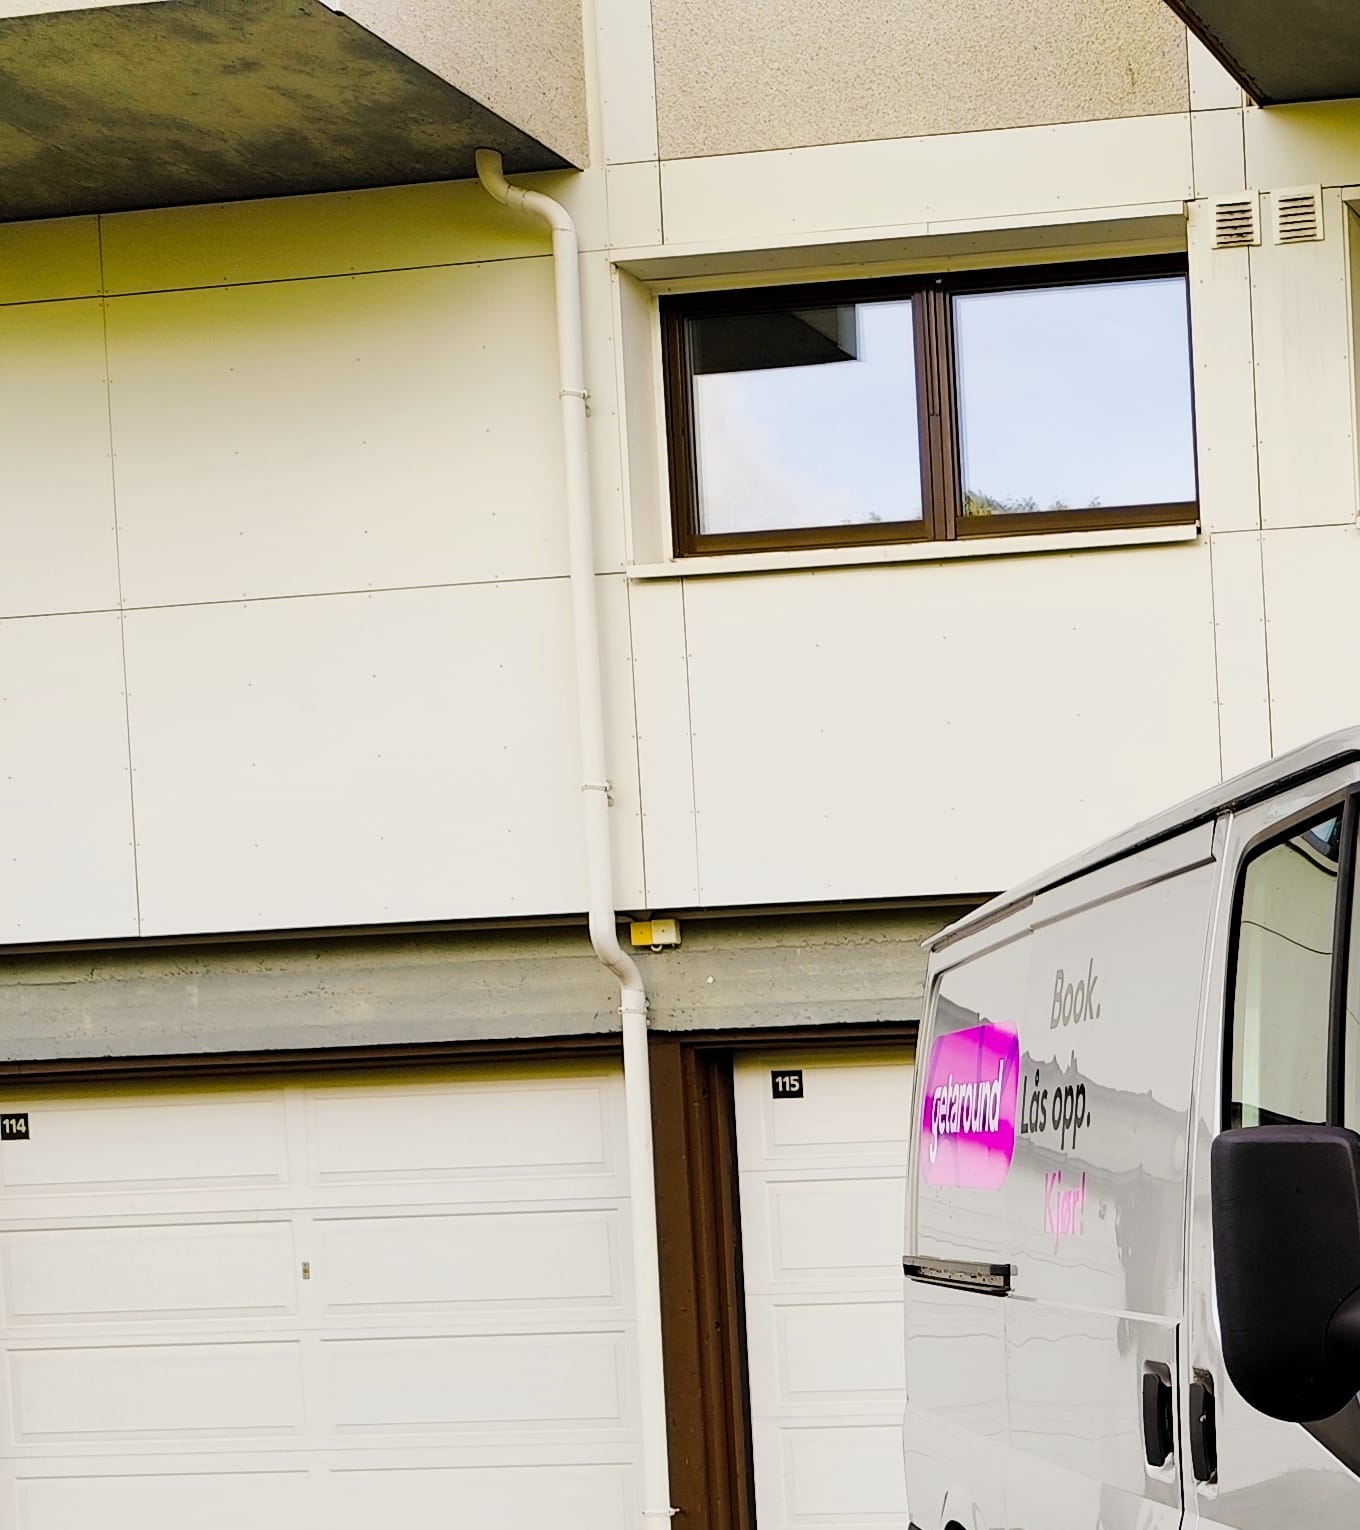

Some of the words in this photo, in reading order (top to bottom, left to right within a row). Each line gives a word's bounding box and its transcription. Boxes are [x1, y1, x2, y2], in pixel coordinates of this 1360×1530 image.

[1050, 957, 1101, 1030] Book.
[775, 1075, 800, 1092] 115
[929, 1059, 1005, 1164] getaround
[1020, 1068, 1048, 1134] Lås
[1051, 1082, 1091, 1150] opp.
[2, 1118, 27, 1134] 114
[1043, 1169, 1086, 1256] Kjør!
